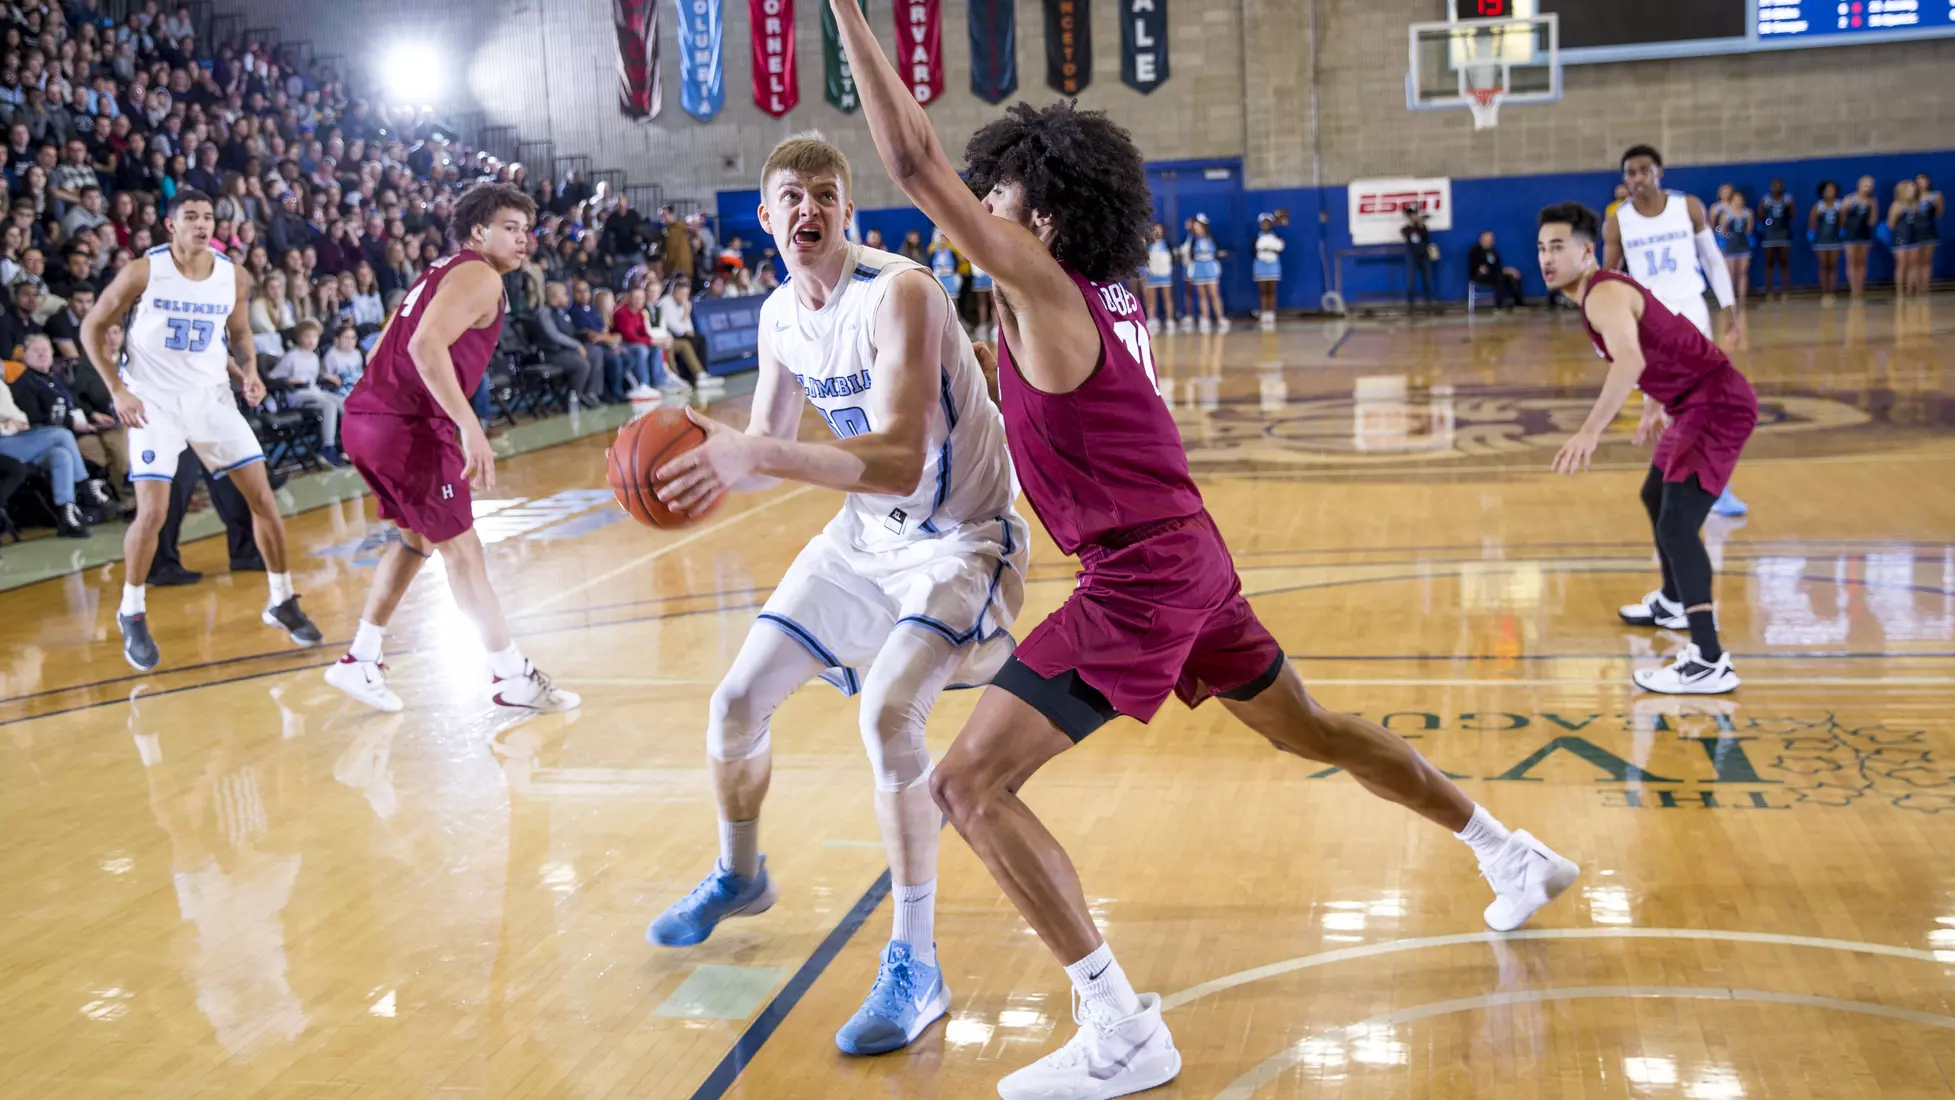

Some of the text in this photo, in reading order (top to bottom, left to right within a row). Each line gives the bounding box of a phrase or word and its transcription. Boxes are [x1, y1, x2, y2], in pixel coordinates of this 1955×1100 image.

[693, 0, 712, 114] OLUMBIA
[764, 0, 785, 112] ORNELL
[909, 0, 932, 102] RVARD
[1060, 1, 1078, 92] NCETON
[1132, 0, 1158, 82] ALE
[1644, 247, 1677, 277] 14
[153, 298, 229, 315] COLUMBIA
[165, 317, 215, 352] 33
[815, 406, 871, 440] 0
[441, 483, 454, 500] H
[1345, 711, 1741, 733] LEAGU
[1597, 789, 1792, 809] THE
